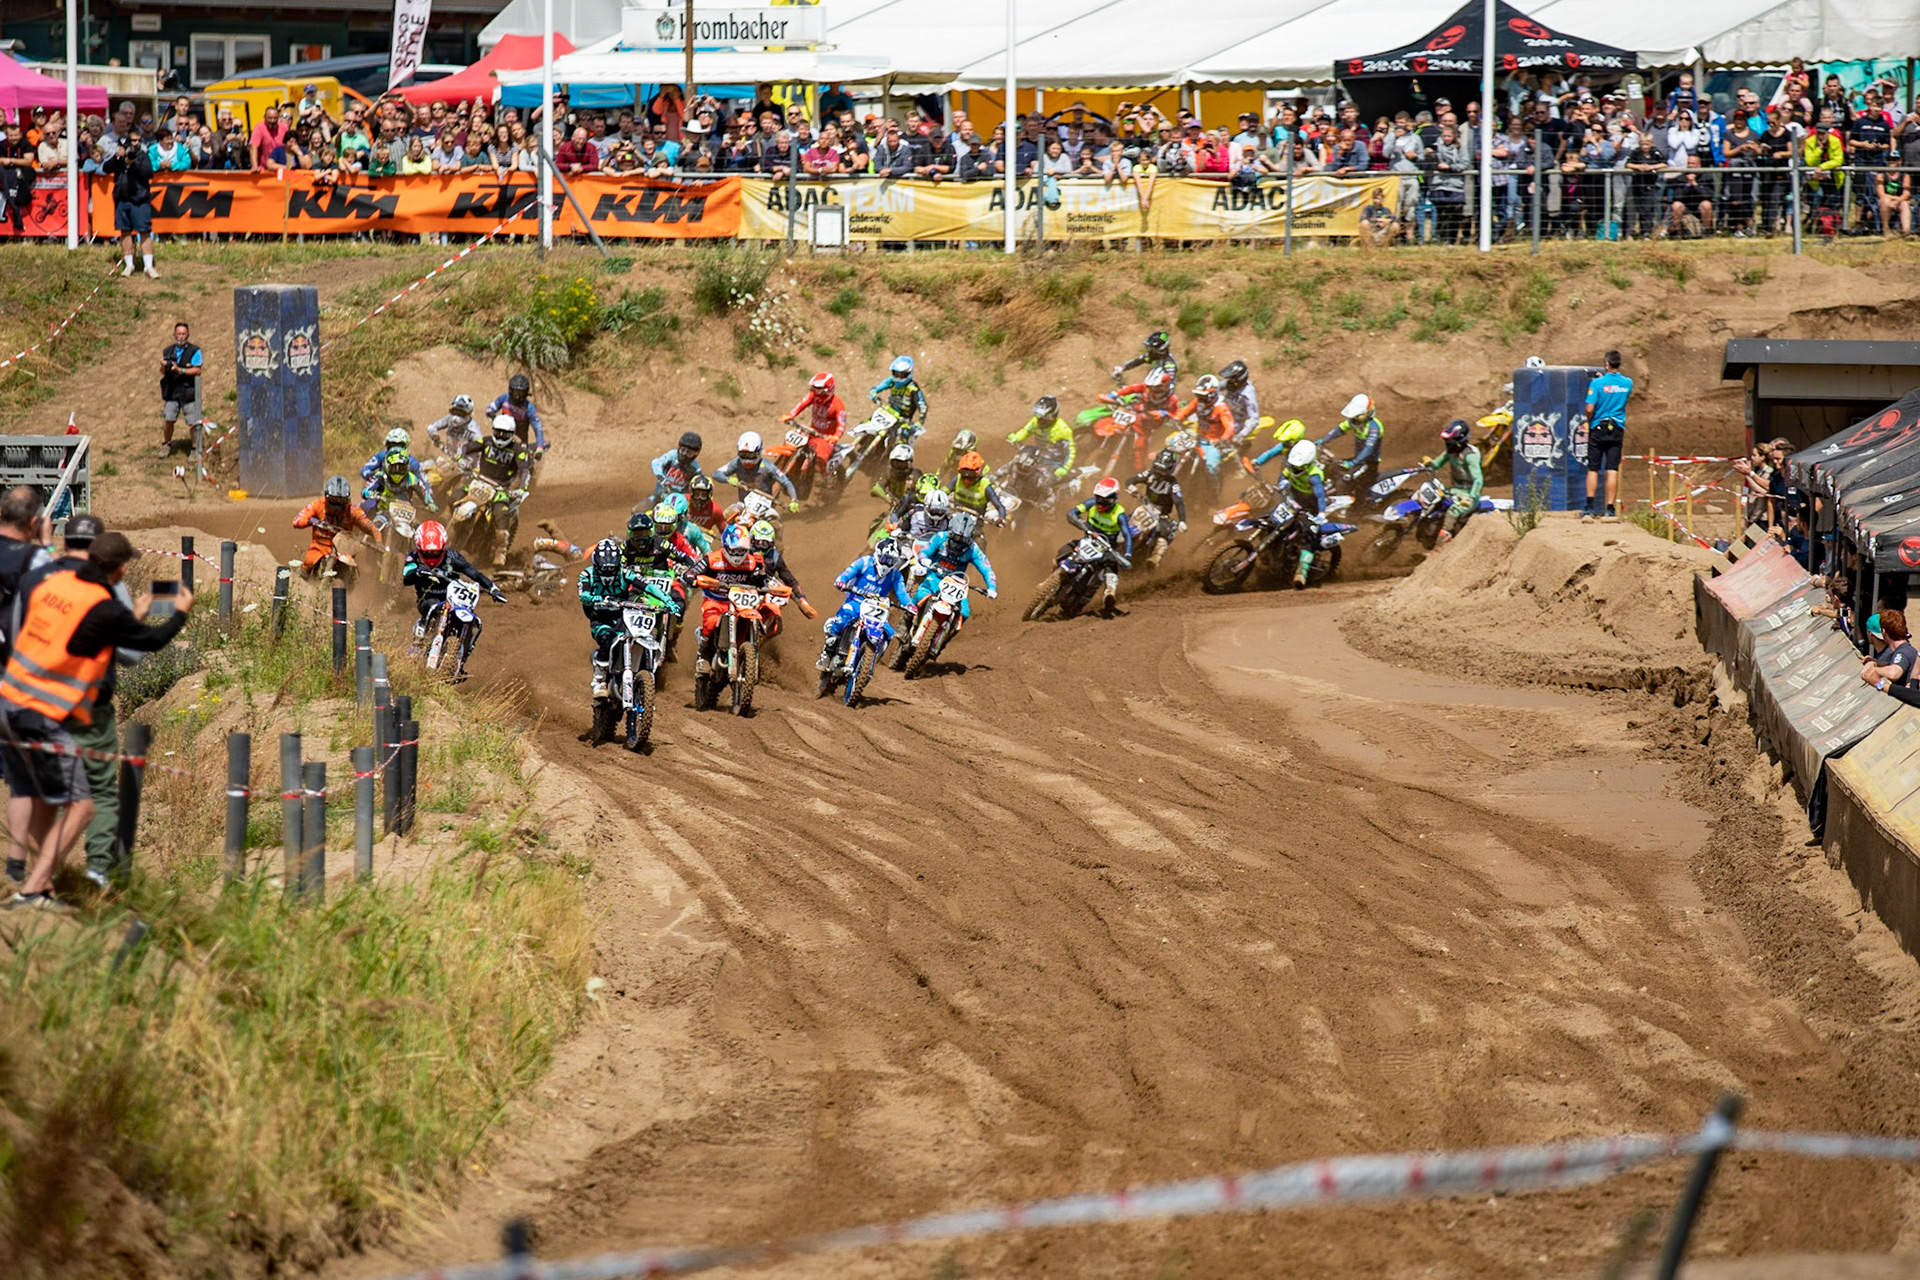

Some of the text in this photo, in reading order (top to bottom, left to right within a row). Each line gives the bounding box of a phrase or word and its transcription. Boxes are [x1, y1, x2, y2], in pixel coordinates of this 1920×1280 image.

[679, 12, 788, 40] Krombacher
[150, 183, 234, 218] TM
[284, 183, 400, 219] KTM
[448, 184, 566, 219] KTM
[591, 186, 708, 223] KTM
[768, 187, 839, 212] ADAC
[1212, 187, 1285, 211] ADAC
[850, 214, 893, 224] chleswig-
[1114, 412, 1133, 422] 114
[487, 446, 515, 464] FXR
[1081, 544, 1099, 558] 101
[452, 586, 478, 607] 754
[733, 593, 757, 607] 262
[942, 582, 965, 600] 226
[41, 592, 73, 615] ADAC
[864, 606, 885, 620] 22
